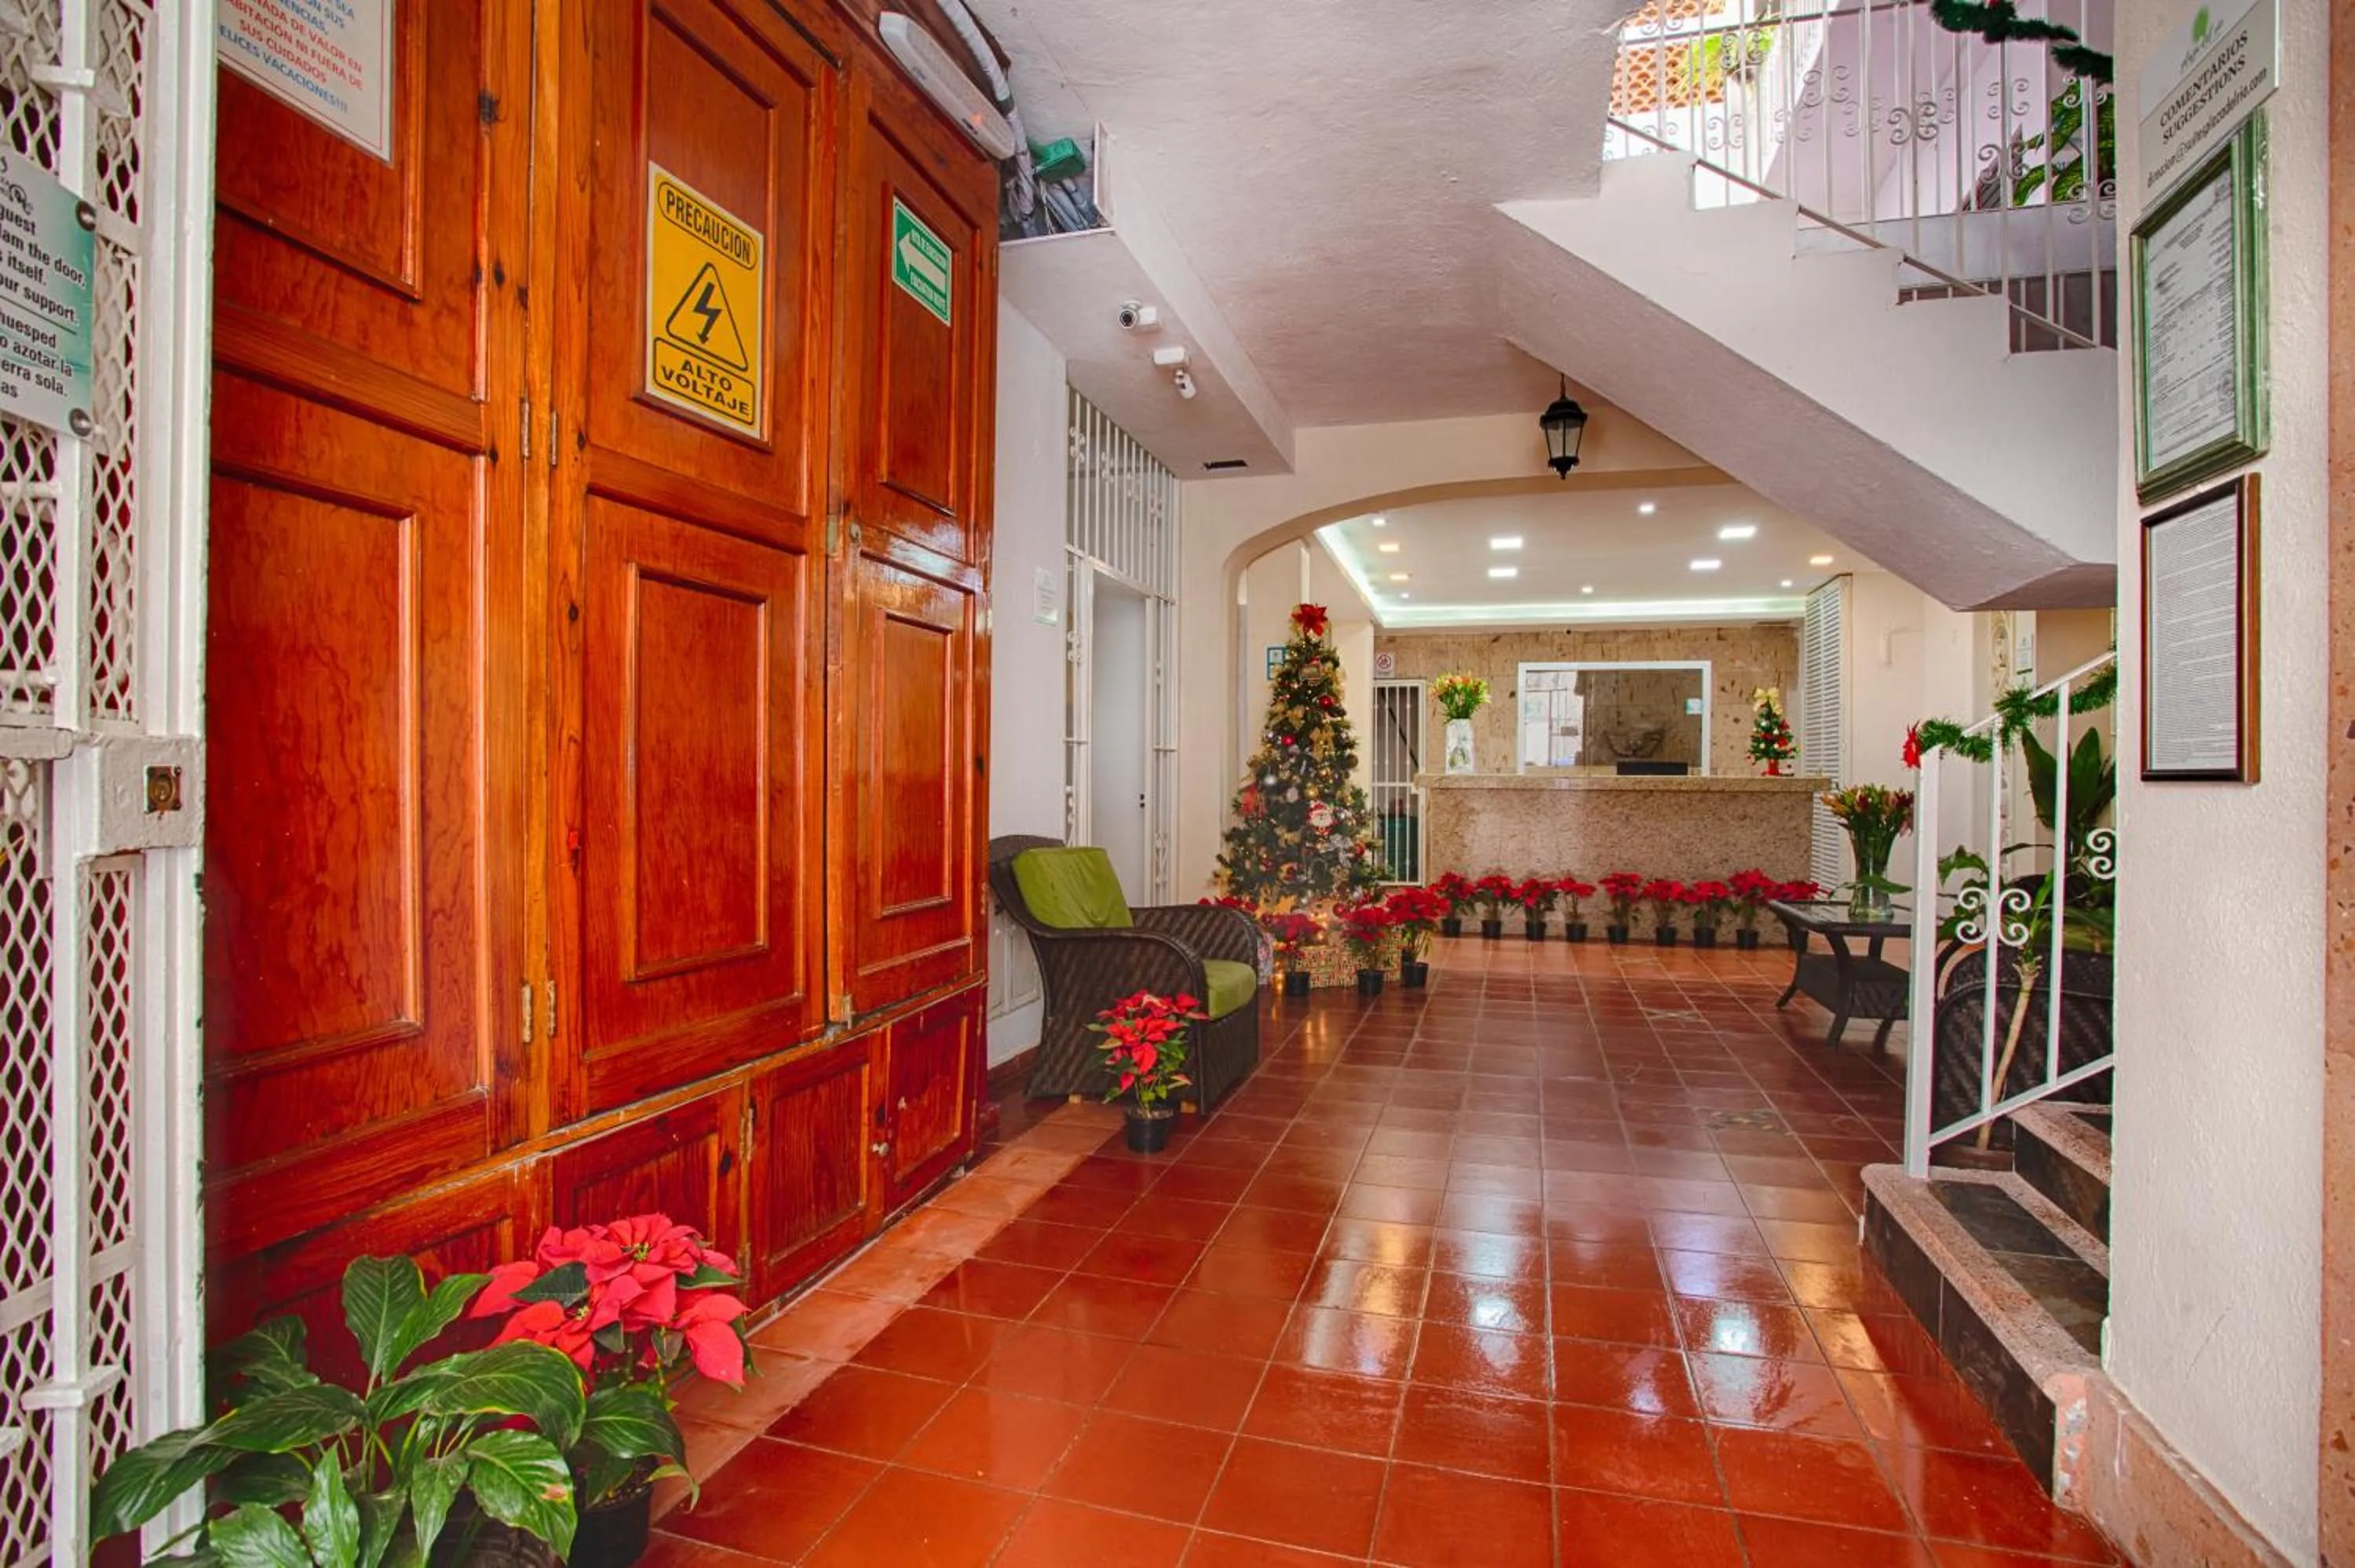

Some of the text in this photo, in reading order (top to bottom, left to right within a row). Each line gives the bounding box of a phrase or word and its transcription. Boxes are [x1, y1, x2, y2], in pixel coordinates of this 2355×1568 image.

[219, 24, 260, 57] ELICES
[239, 18, 327, 83] SUS CUIDADOS
[290, 18, 305, 35] DE
[308, 27, 346, 63] VALOR
[311, 49, 347, 81] FUERA
[2160, 30, 2248, 128] COMENTARIOS
[2163, 54, 2246, 145] SUGGESTIONS
[0, 222, 24, 251] lam
[28, 242, 51, 265] the
[666, 188, 750, 264] PRECAUCION
[8, 250, 46, 286] itself.
[24, 286, 78, 324] support.
[13, 341, 55, 370] azotar
[60, 359, 72, 377] la
[681, 359, 732, 392] ALTO
[35, 374, 68, 398] sola.
[660, 364, 750, 417] VOLTAJE
